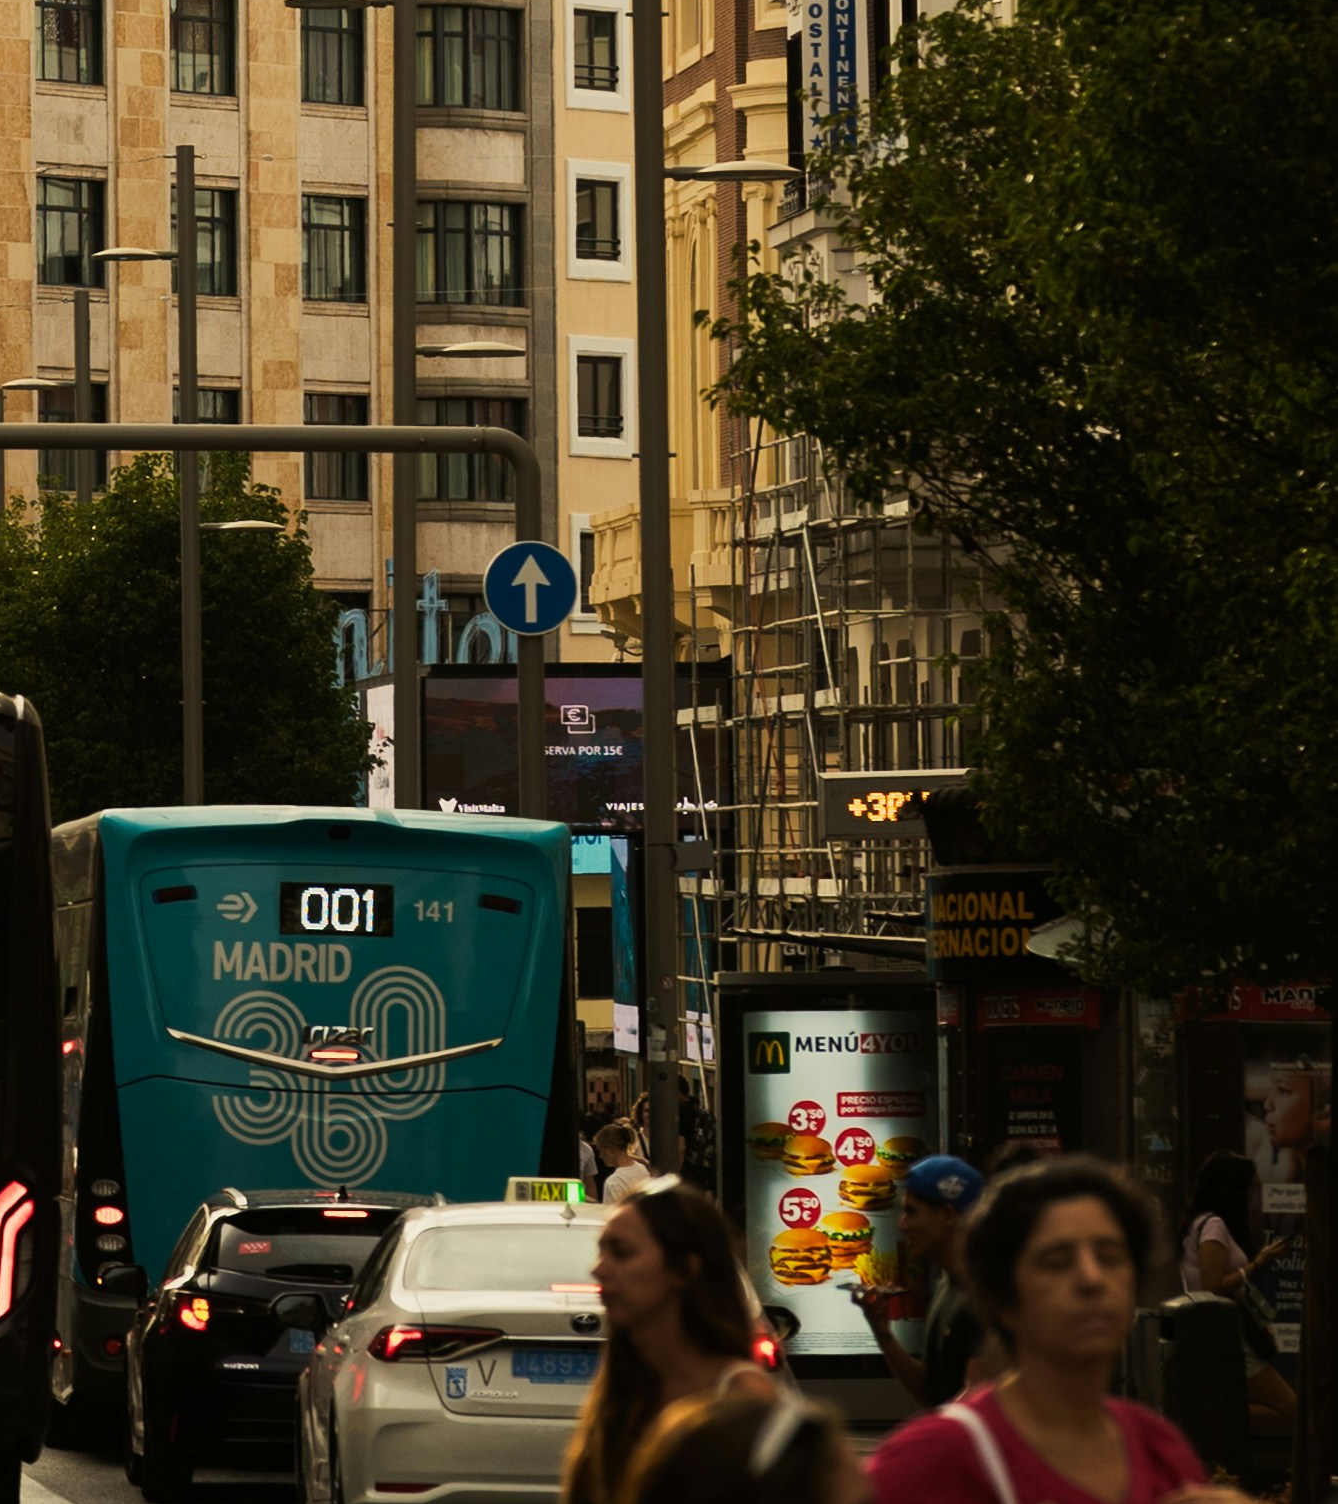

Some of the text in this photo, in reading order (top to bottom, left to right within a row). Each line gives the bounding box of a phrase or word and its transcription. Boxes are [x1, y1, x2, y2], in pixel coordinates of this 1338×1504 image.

[578, 746, 602, 755] POR
[603, 745, 623, 755] 15€
[605, 803, 645, 812] VIAJES
[301, 887, 375, 932] 001
[413, 900, 454, 923] 141
[214, 941, 352, 983] MADRID
[999, 1063, 1064, 1081] CARMEN
[841, 1096, 876, 1105] PRECIO
[1008, 1086, 1052, 1104] MOLA
[841, 1106, 855, 1115] por
[533, 1182, 566, 1201] TAXI
[528, 1353, 589, 1375] 4893
[477, 1360, 497, 1387] V
